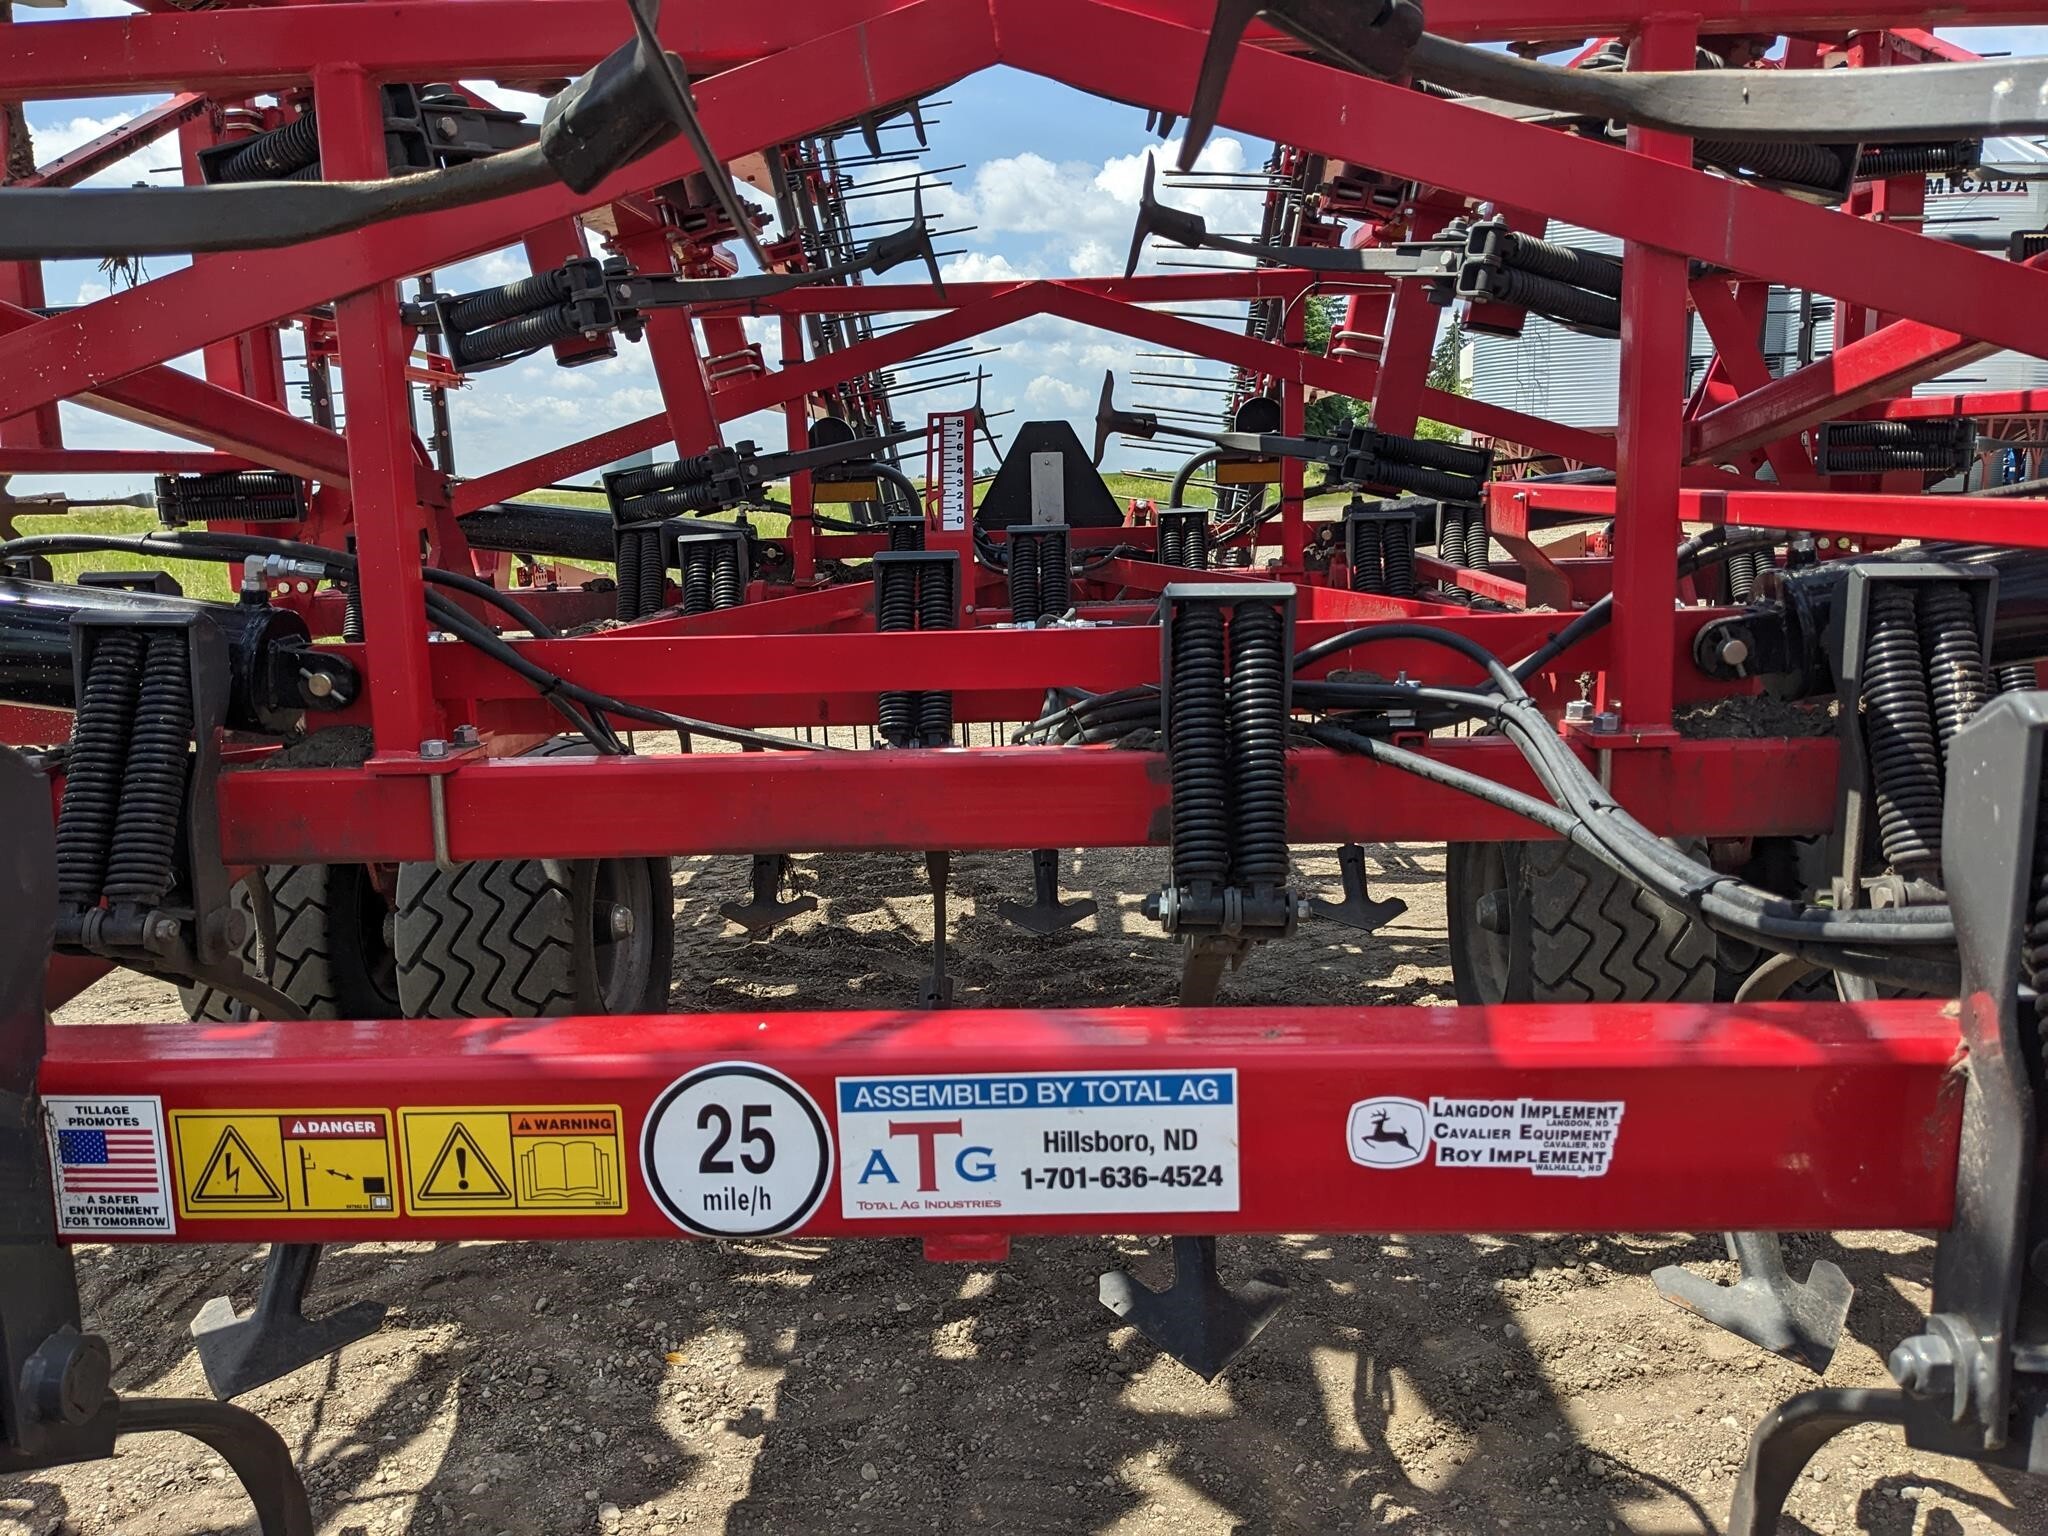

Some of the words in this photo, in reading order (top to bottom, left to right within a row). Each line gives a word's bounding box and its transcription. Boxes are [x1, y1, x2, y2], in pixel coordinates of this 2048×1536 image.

[854, 1083, 1028, 1108] ASSEMBLED
[1036, 1081, 1073, 1103] BY
[1081, 1080, 1170, 1102] TOTAL
[1177, 1079, 1219, 1101] AG
[75, 1106, 130, 1115] TILLAGE
[68, 1117, 139, 1127] PROMOTES
[308, 1121, 376, 1133] DANGER
[535, 1118, 612, 1130] WARNING
[696, 1103, 776, 1174] 25
[1043, 1130, 1155, 1155] Hillsboro,
[1163, 1129, 1198, 1151] ND
[1536, 1164, 1585, 1172] WALHALLA,
[1021, 1166, 1223, 1190] 1-701-636-4524
[87, 1195, 95, 1204] A
[98, 1195, 139, 1204] SAFER
[703, 1185, 771, 1216] mile/h
[69, 1206, 159, 1215] ENVIRONMENT
[65, 1217, 90, 1226] FOR
[92, 1217, 166, 1226] TOMORROW
